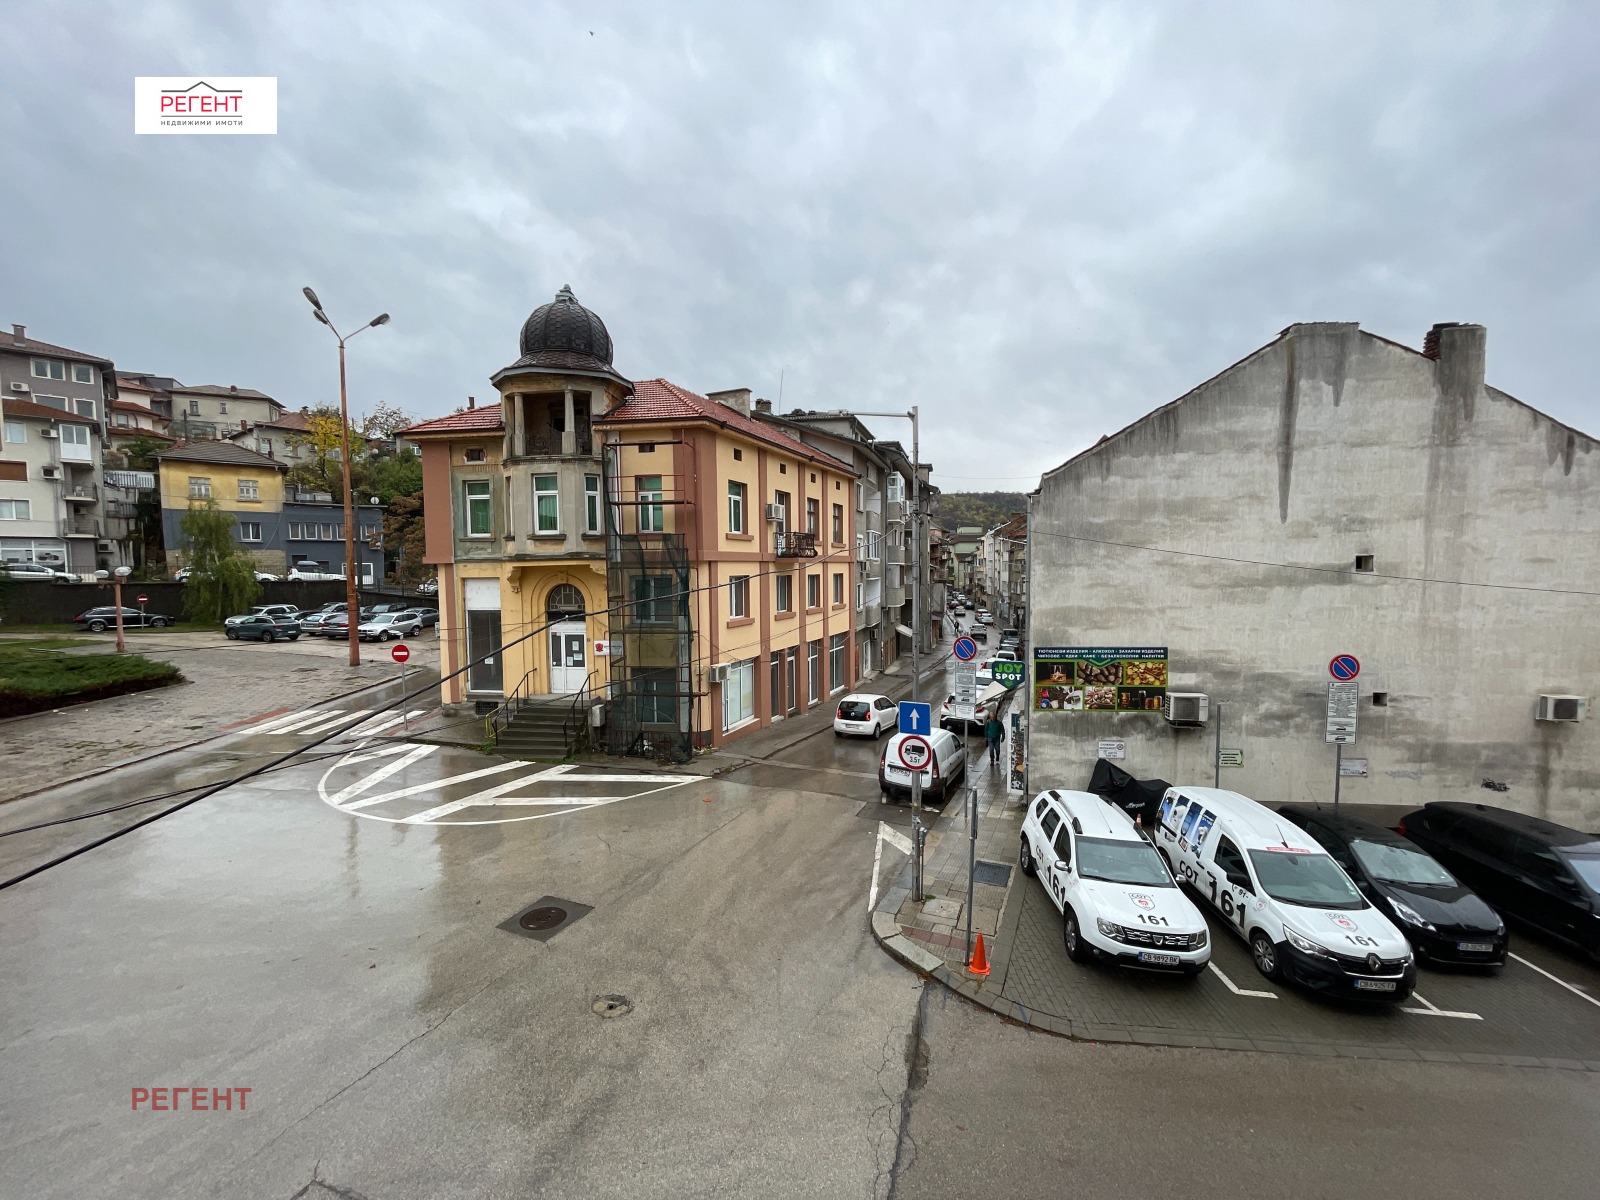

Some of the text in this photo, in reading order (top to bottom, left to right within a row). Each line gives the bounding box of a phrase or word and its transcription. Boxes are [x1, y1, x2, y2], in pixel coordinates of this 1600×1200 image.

[995, 663, 1023, 673] JOY
[995, 673, 1022, 681] SPOT
[1047, 865, 1065, 907] 161
[1209, 880, 1246, 930] 161
[1137, 914, 1169, 927] 161
[1345, 935, 1380, 947] 161
